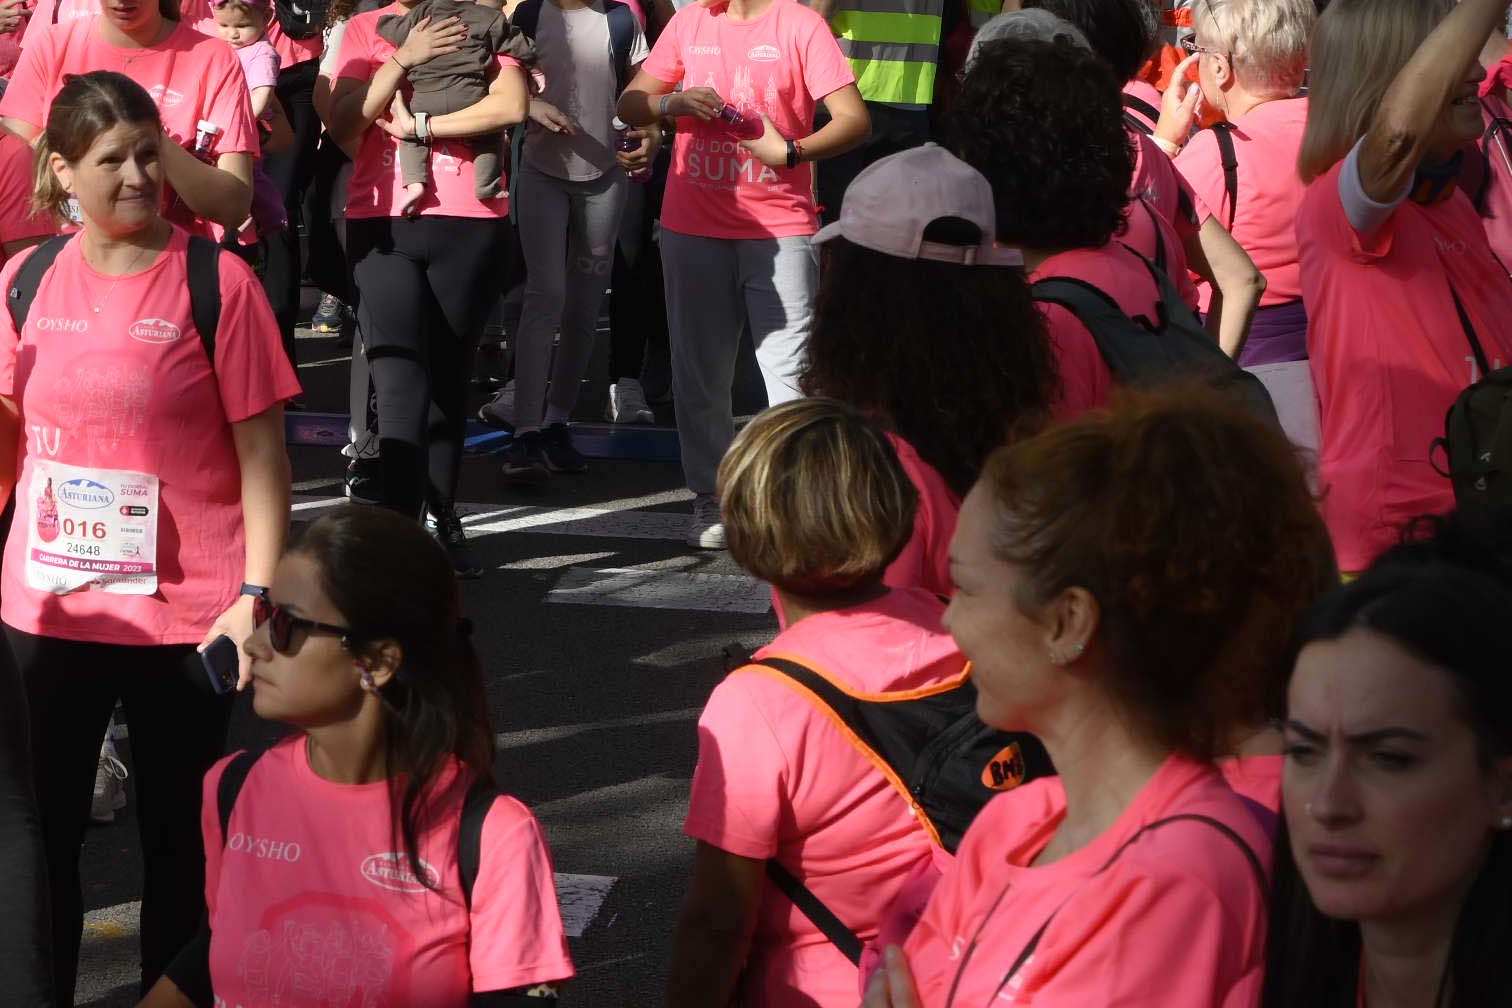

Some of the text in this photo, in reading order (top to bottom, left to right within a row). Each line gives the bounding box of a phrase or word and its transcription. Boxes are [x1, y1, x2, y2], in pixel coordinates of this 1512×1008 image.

[688, 154, 778, 183] SUMA
[36, 317, 88, 334] OYSHO
[130, 324, 179, 339] ASTURIANA
[31, 426, 61, 456] TU
[62, 488, 110, 504] ASTURIANA
[120, 488, 148, 496] SUMA
[63, 518, 107, 539] 016
[66, 542, 100, 556] 24648
[69, 559, 79, 568] DE
[80, 561, 91, 569] LA
[92, 563, 120, 572] MUJER
[123, 564, 142, 572] 2023
[228, 832, 301, 863] OYSHO
